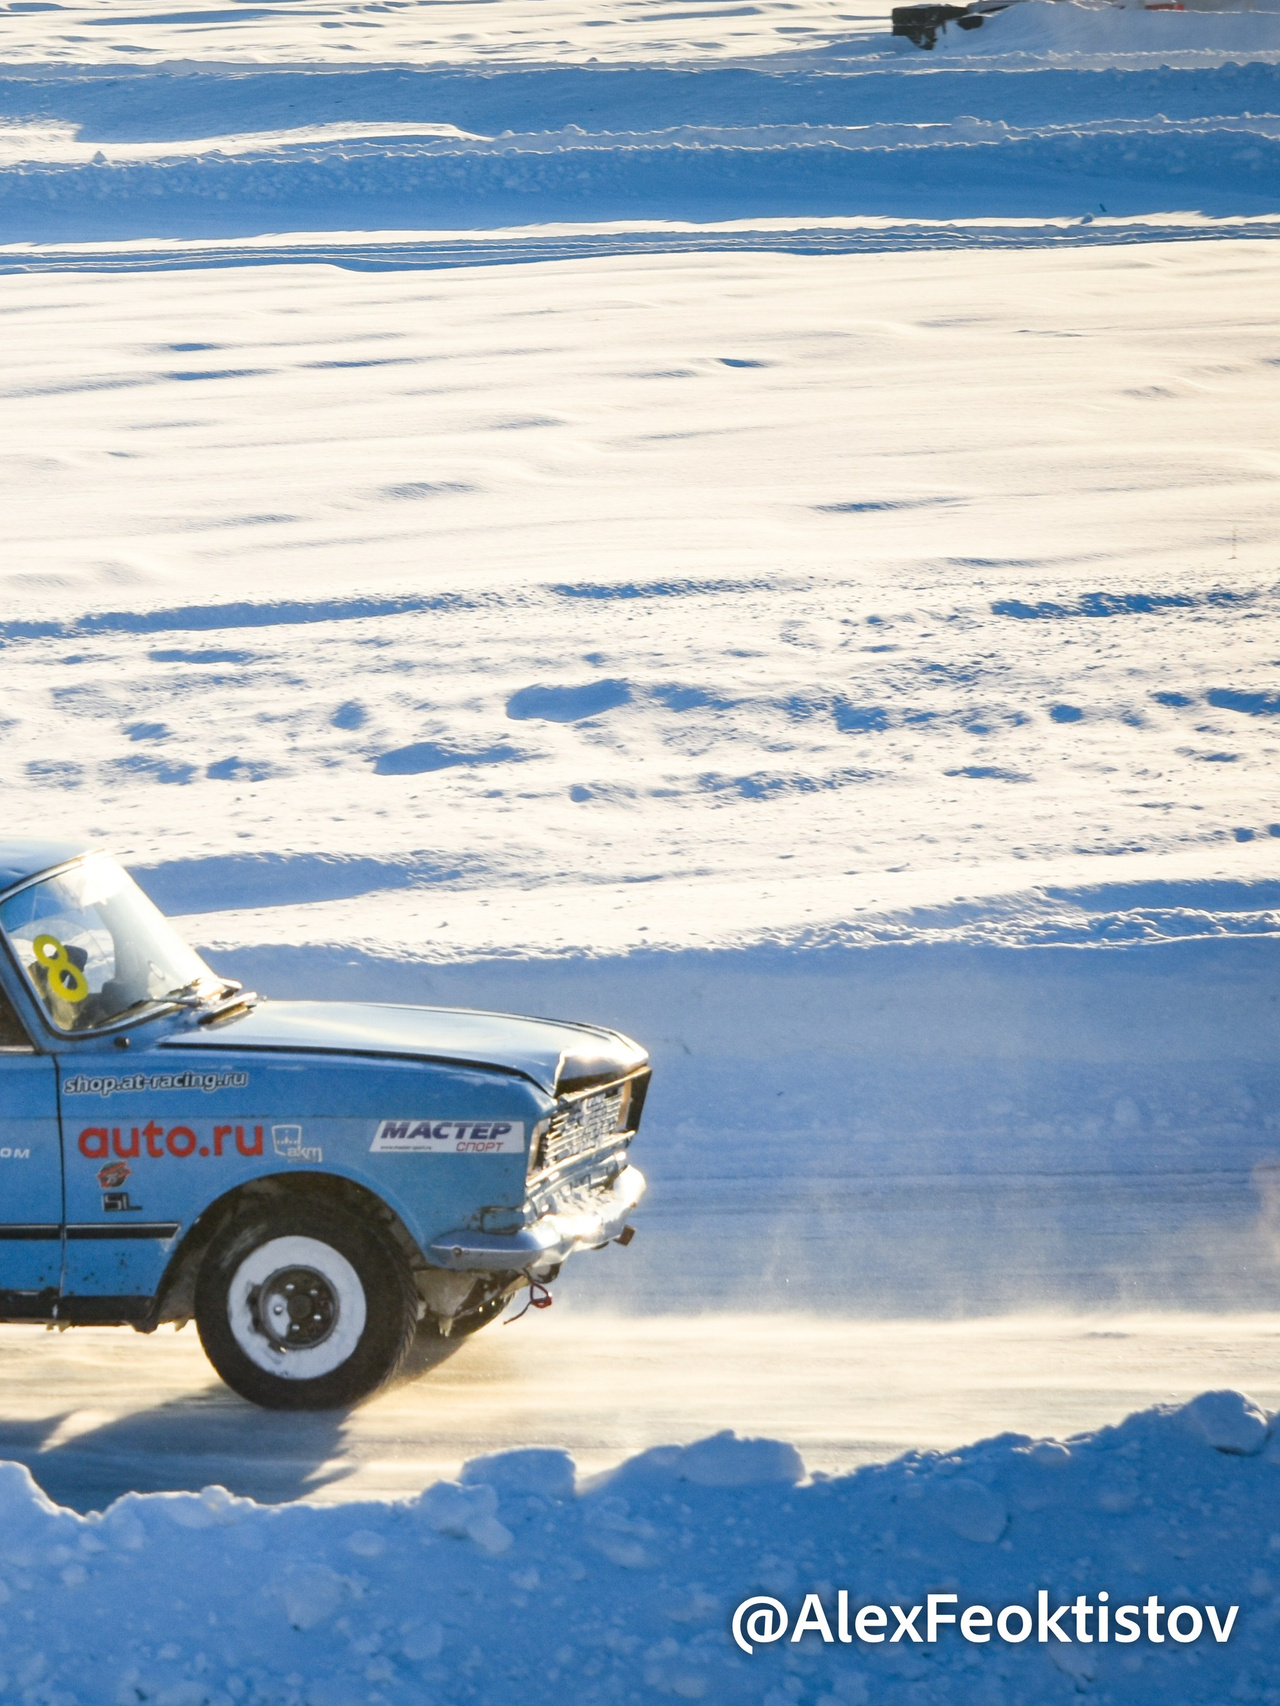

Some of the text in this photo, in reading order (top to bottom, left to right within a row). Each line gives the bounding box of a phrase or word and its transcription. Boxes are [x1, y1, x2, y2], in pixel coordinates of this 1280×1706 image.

[32, 933, 88, 1002] 8
[64, 1071, 248, 1097] shop.at-racing.ru
[78, 1120, 264, 1158] auto.ru
[381, 1122, 512, 1140] МАСТЕР
[456, 1141, 504, 1152] СПОРТ
